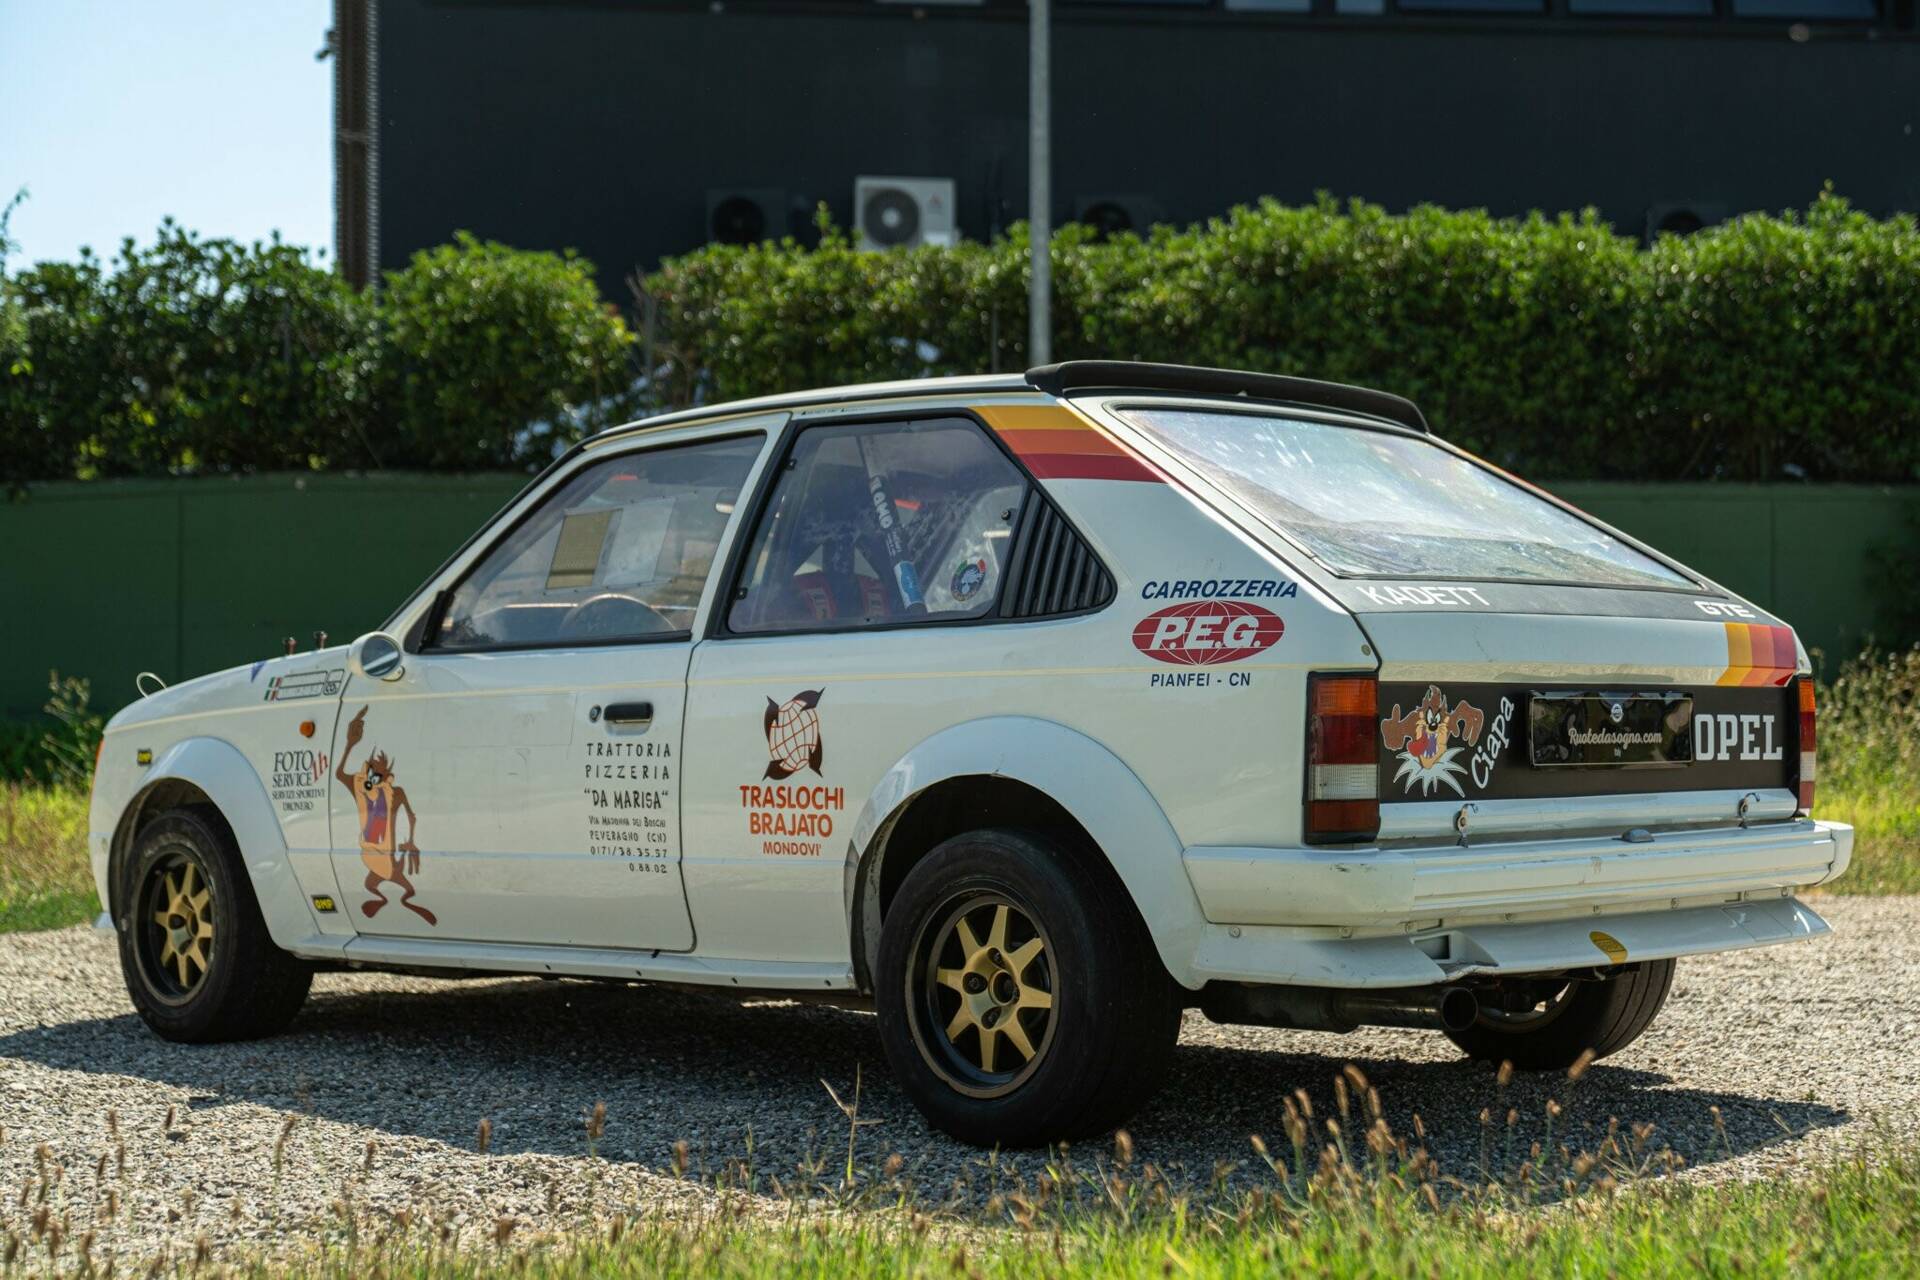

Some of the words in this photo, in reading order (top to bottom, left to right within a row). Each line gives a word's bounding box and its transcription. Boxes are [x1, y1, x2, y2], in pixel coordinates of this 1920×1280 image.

[1141, 579, 1298, 600] CARROZZERIA
[1356, 586, 1490, 606] KADETT
[1694, 600, 1756, 618] GTE
[1149, 615, 1261, 650] P.E.G.
[1151, 673, 1210, 687] PIANFEI
[1229, 672, 1251, 687] CN
[1471, 696, 1515, 789] Ciapa
[1568, 727, 1663, 750] Ruotedasogno.com
[1694, 713, 1783, 761] OPEL
[586, 742, 671, 758] TRATTORIA
[273, 750, 314, 772] FOTO
[272, 772, 312, 788] SERVICE
[585, 764, 670, 780] PIZZERIA
[740, 785, 844, 810] TRASLOCHI
[749, 812, 834, 838] BRAJATO
[589, 830, 639, 842] PEVERAGNO
[647, 832, 667, 843] (CN)
